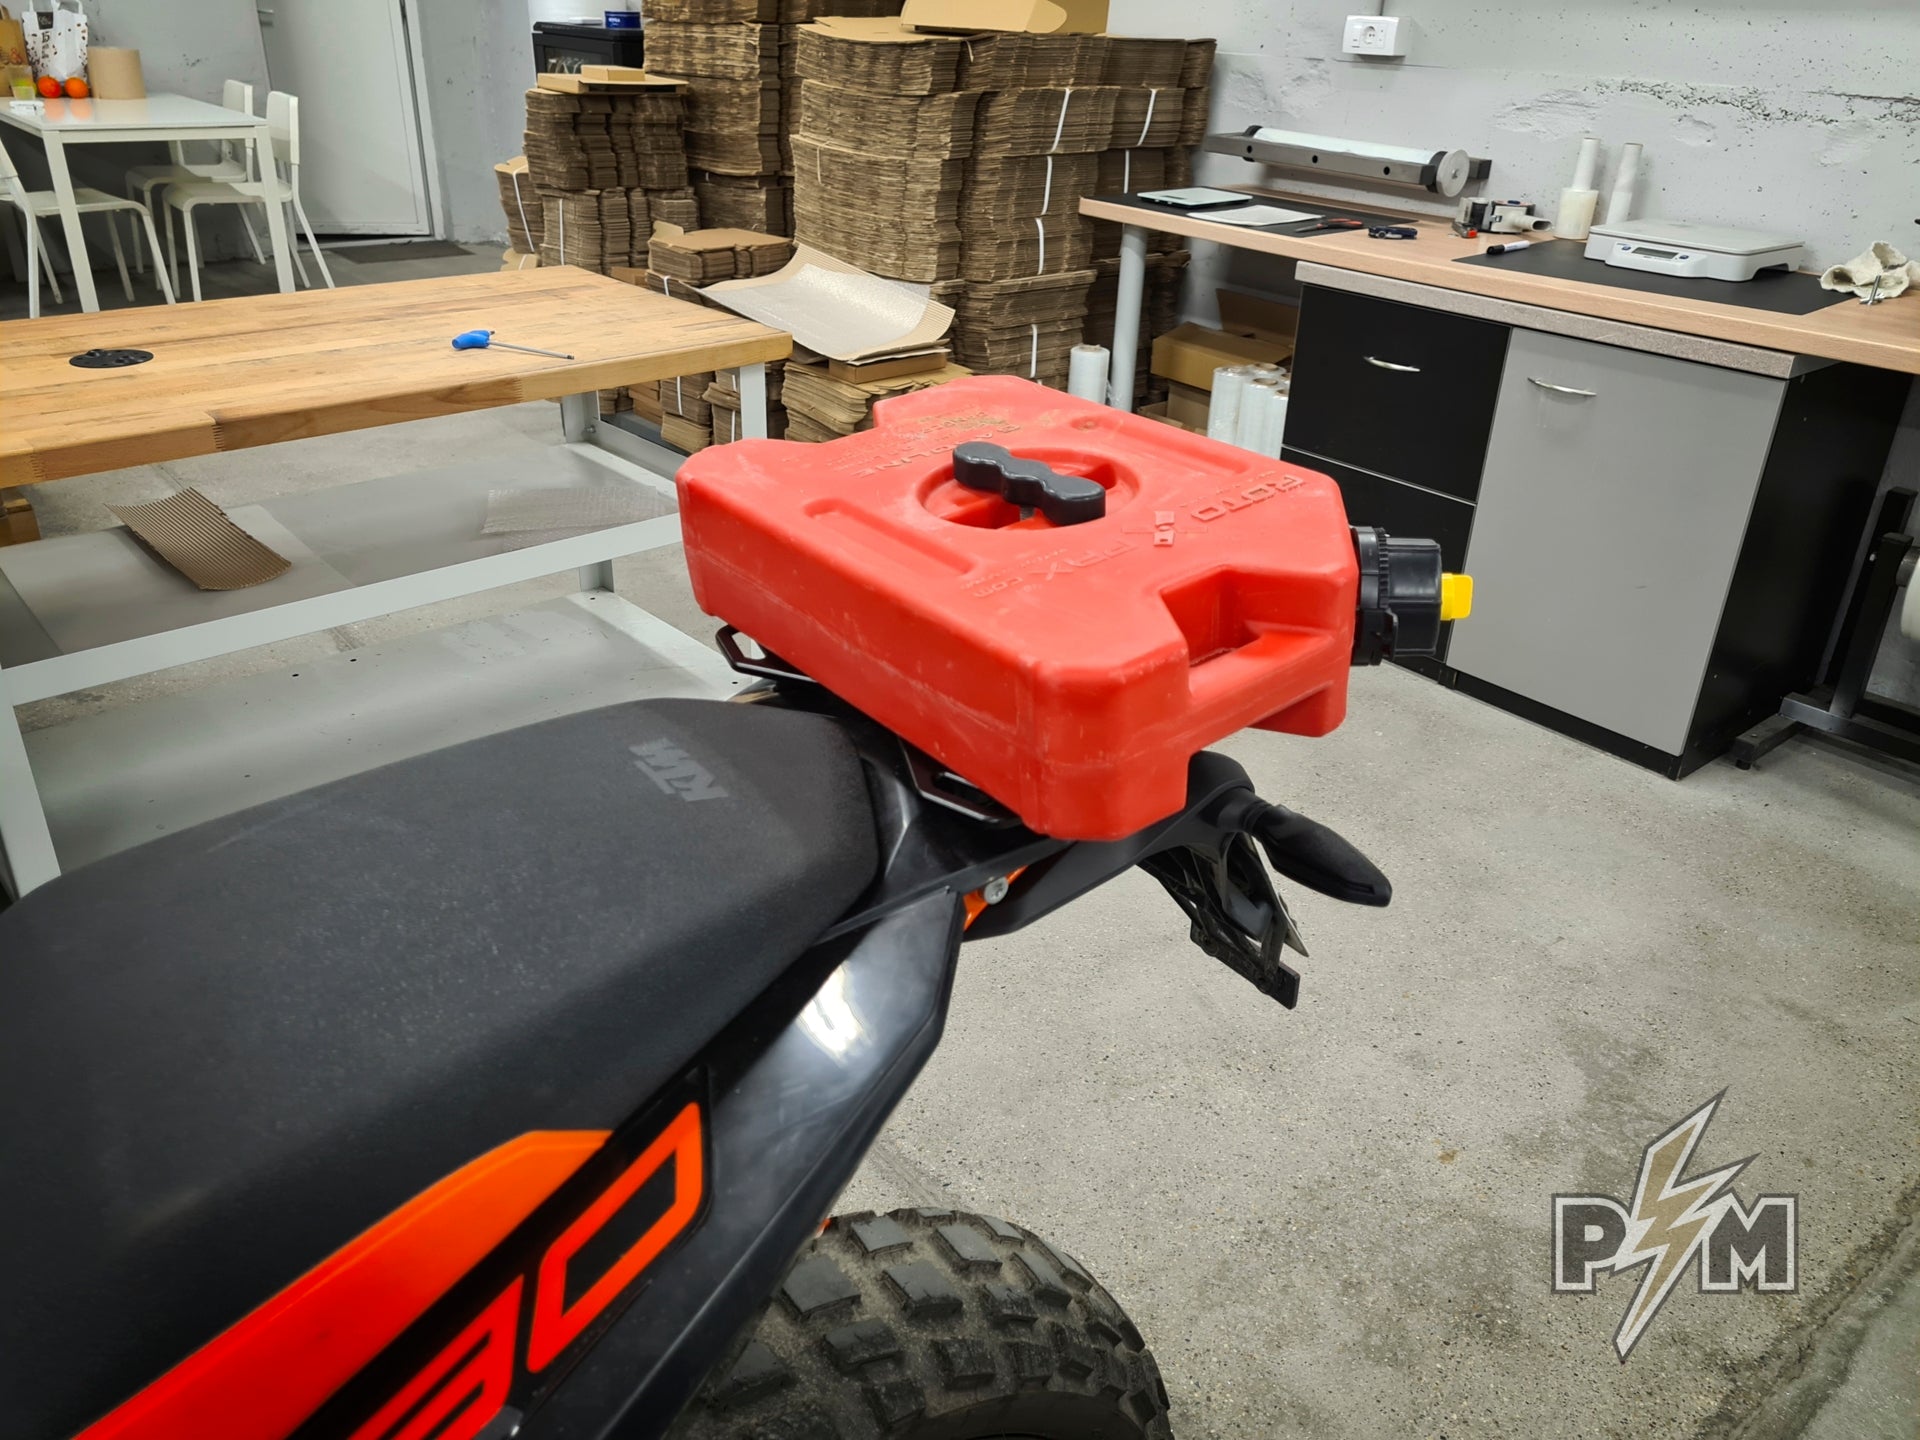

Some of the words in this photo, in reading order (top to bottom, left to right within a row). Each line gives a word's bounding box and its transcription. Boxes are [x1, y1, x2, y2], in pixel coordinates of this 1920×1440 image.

[852, 423, 1021, 478] GAOLINE
[1190, 473, 1304, 523] ROTO
[628, 737, 729, 802] KTM
